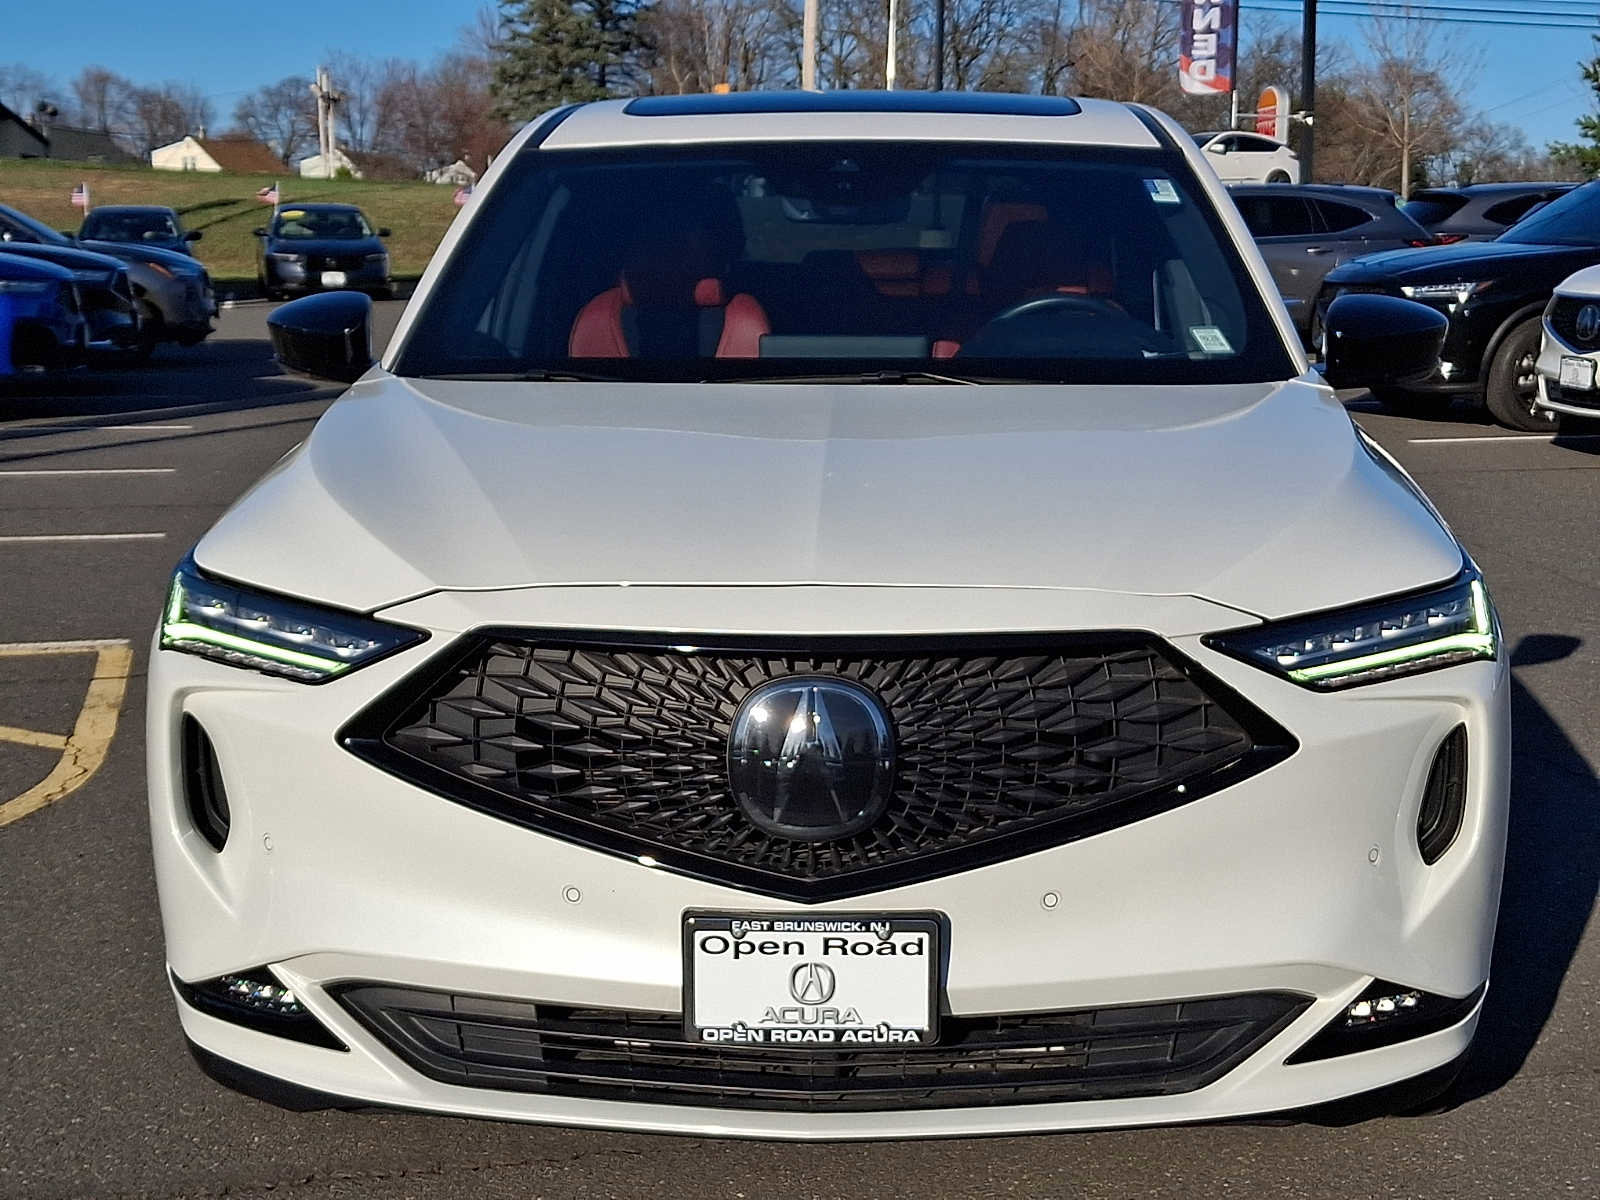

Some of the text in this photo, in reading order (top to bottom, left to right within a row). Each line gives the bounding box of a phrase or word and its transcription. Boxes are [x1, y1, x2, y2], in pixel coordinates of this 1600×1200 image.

[732, 921, 770, 931] EAST
[870, 921, 890, 931] NJ
[700, 936, 923, 959] Open Road
[759, 1007, 863, 1024] ACURA
[703, 1028, 920, 1042] OPEN ROAD ACURA
